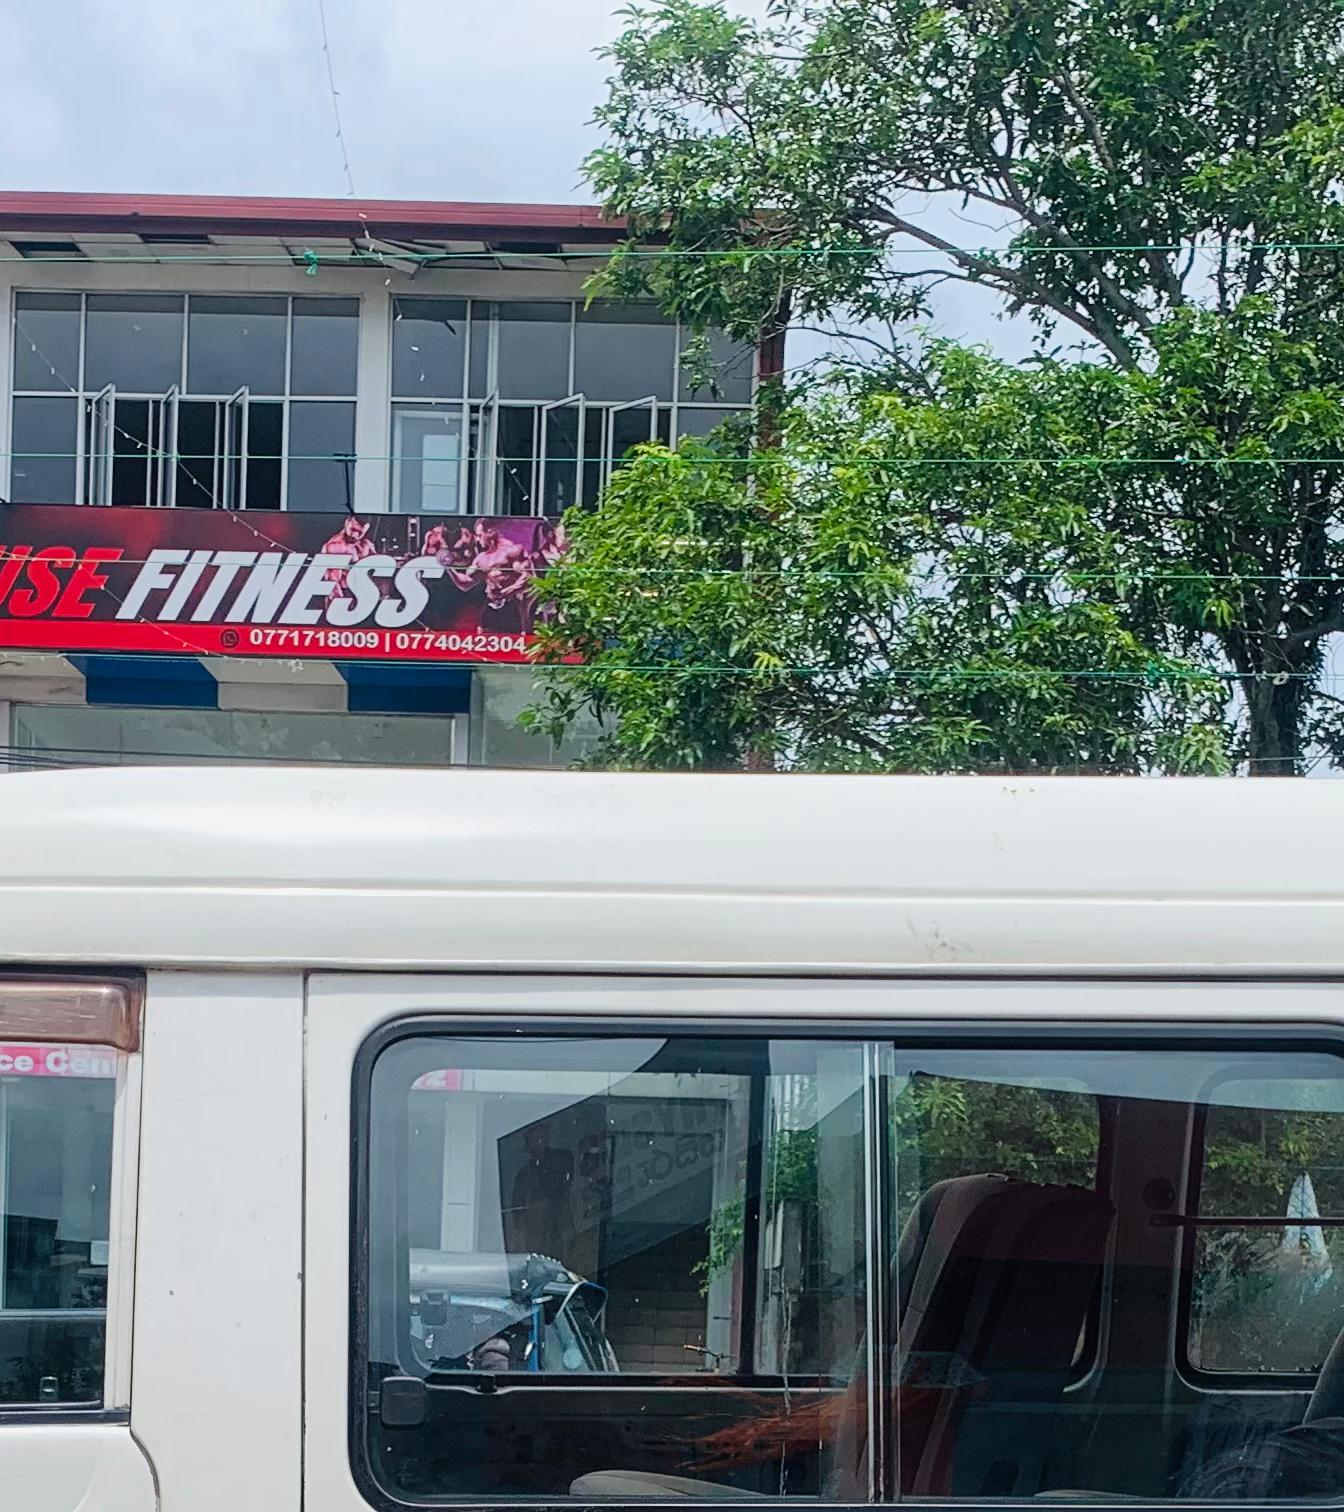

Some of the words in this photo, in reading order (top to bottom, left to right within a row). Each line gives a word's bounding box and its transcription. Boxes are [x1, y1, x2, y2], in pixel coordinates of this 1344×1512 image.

[115, 549, 446, 628] FITNESS
[249, 629, 378, 649] 0771718009
[395, 632, 526, 653] 0774042304
